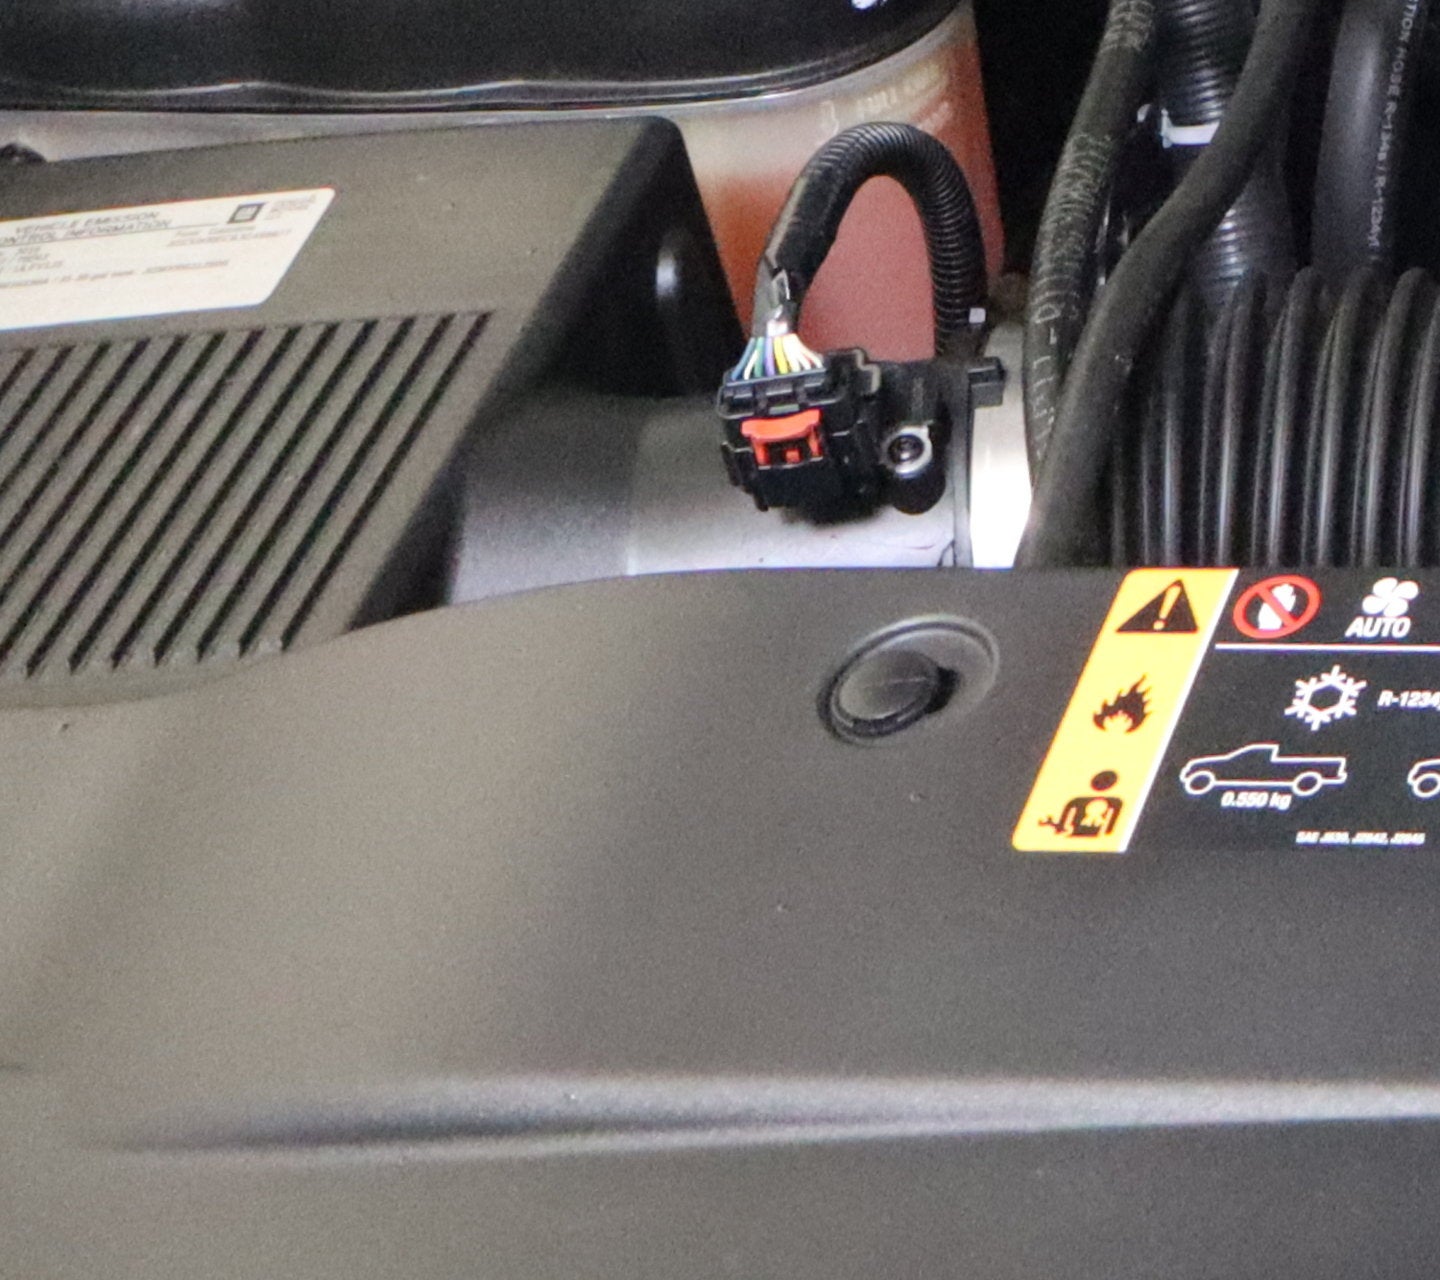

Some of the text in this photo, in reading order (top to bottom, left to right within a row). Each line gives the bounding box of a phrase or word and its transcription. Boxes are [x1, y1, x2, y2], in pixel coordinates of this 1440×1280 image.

[1387, 45, 1407, 96] HOSE
[1345, 616, 1411, 638] AUTO
[1220, 791, 1292, 811] 0.550 kg
